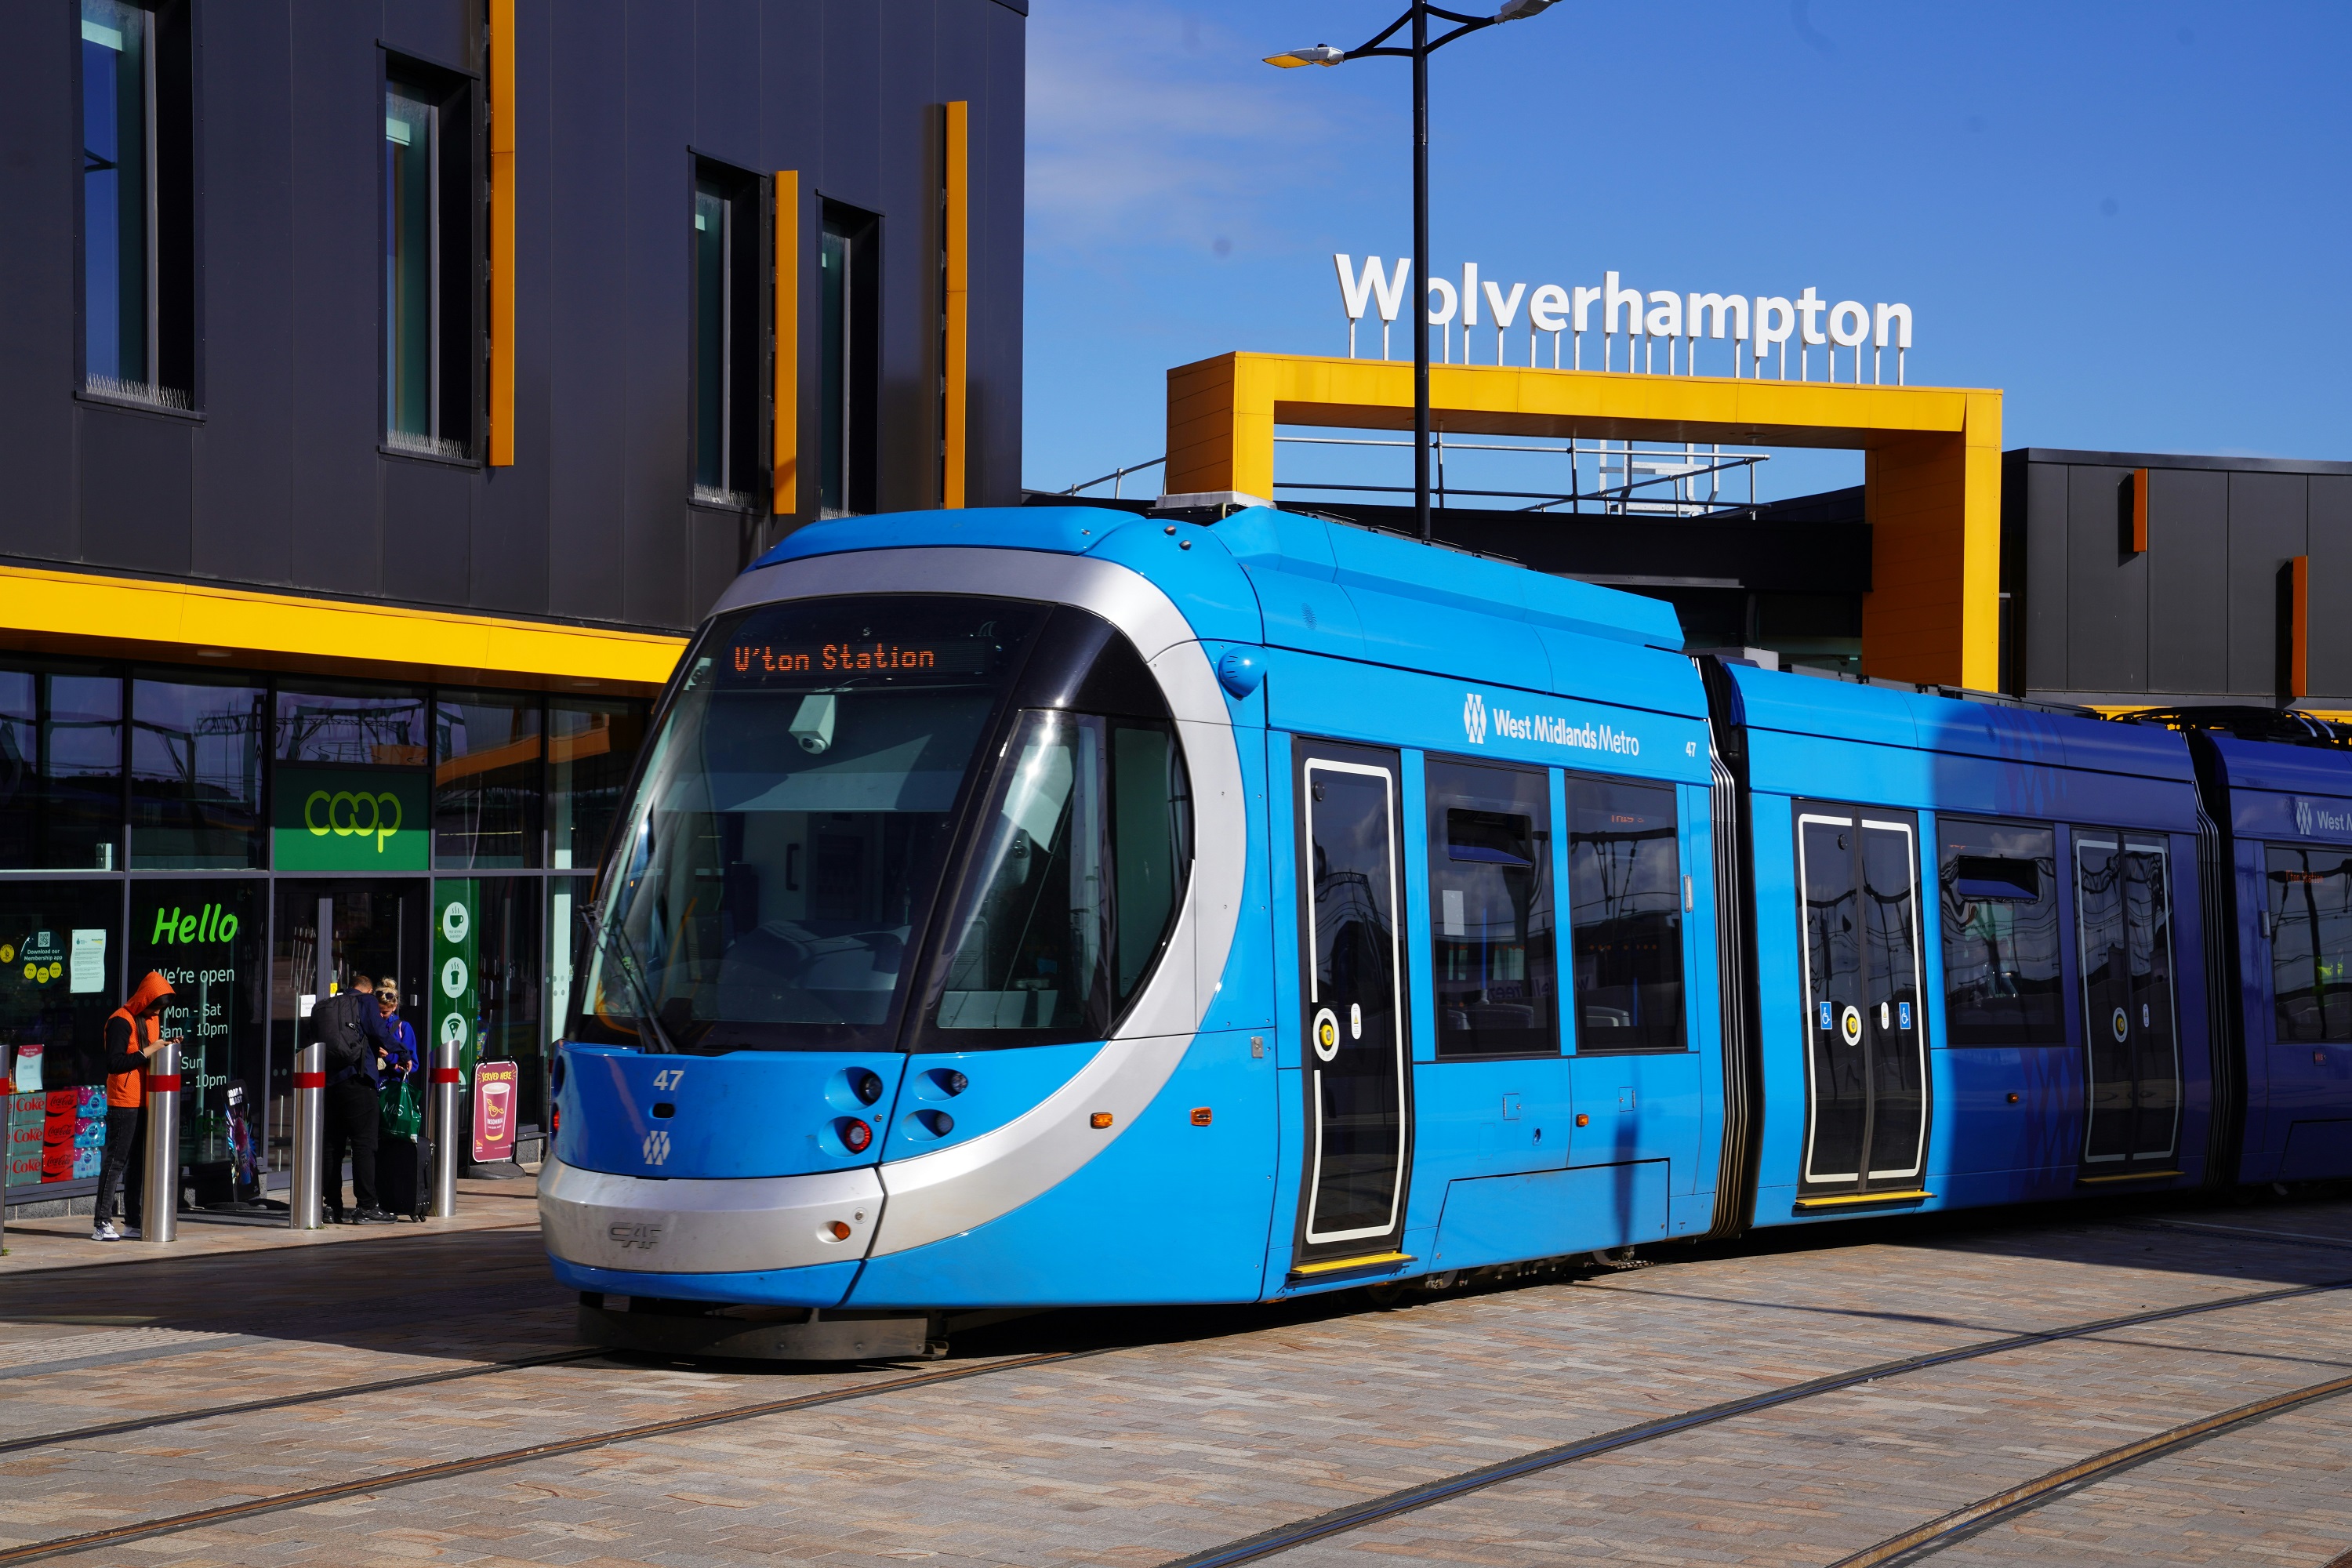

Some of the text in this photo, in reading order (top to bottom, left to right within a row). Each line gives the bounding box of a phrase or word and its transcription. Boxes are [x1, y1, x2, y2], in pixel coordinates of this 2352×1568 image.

[1333, 253, 1912, 357] Wolverhampton
[822, 643, 935, 670] Station
[1493, 708, 1639, 756] West Midlands Metro
[1686, 742, 1697, 757] 47
[305, 790, 402, 853] coop
[2317, 811, 2345, 830] West
[151, 903, 238, 945] Hello
[200, 969, 234, 986] open
[165, 1006, 188, 1018] Mon
[202, 1004, 222, 1017] Sat
[197, 1022, 228, 1038] 10pm
[181, 1056, 203, 1069] Sun
[195, 1074, 227, 1089] 10pm
[482, 1071, 512, 1082] SERVED HERE
[653, 1070, 684, 1091] 47
[16, 1098, 45, 1112] Coke
[13, 1128, 43, 1143] Coke
[13, 1159, 41, 1174] Coke
